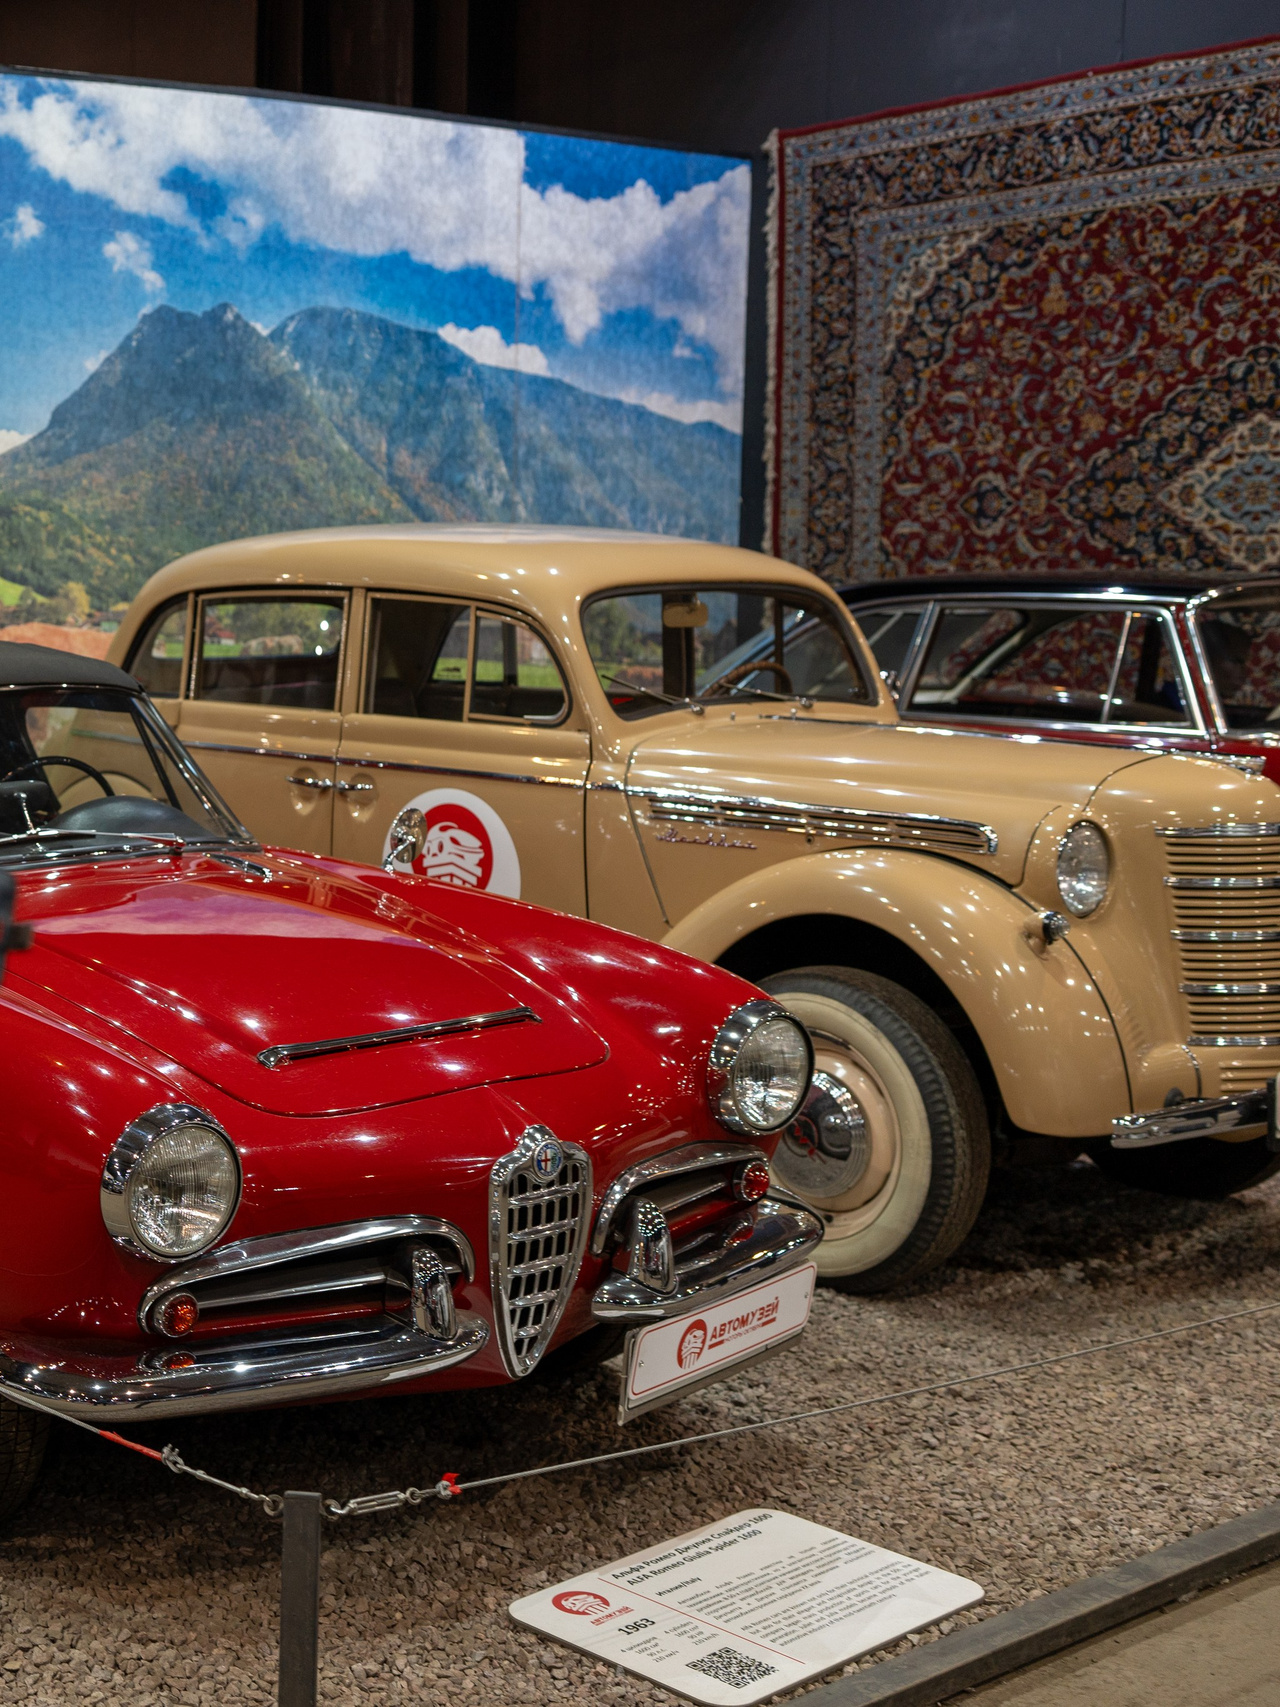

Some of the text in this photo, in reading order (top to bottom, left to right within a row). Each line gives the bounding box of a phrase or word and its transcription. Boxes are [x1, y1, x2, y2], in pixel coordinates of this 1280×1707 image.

[710, 1296, 780, 1341] АВТОМУЗЕЙ
[612, 1513, 773, 1580] Альфа Ромео Джулия Спайдер 1600
[627, 1529, 762, 1586] ALFA Romeo Giulia Spider 1600
[655, 1577, 702, 1597] Италия/Italy
[618, 1618, 656, 1636] 1963
